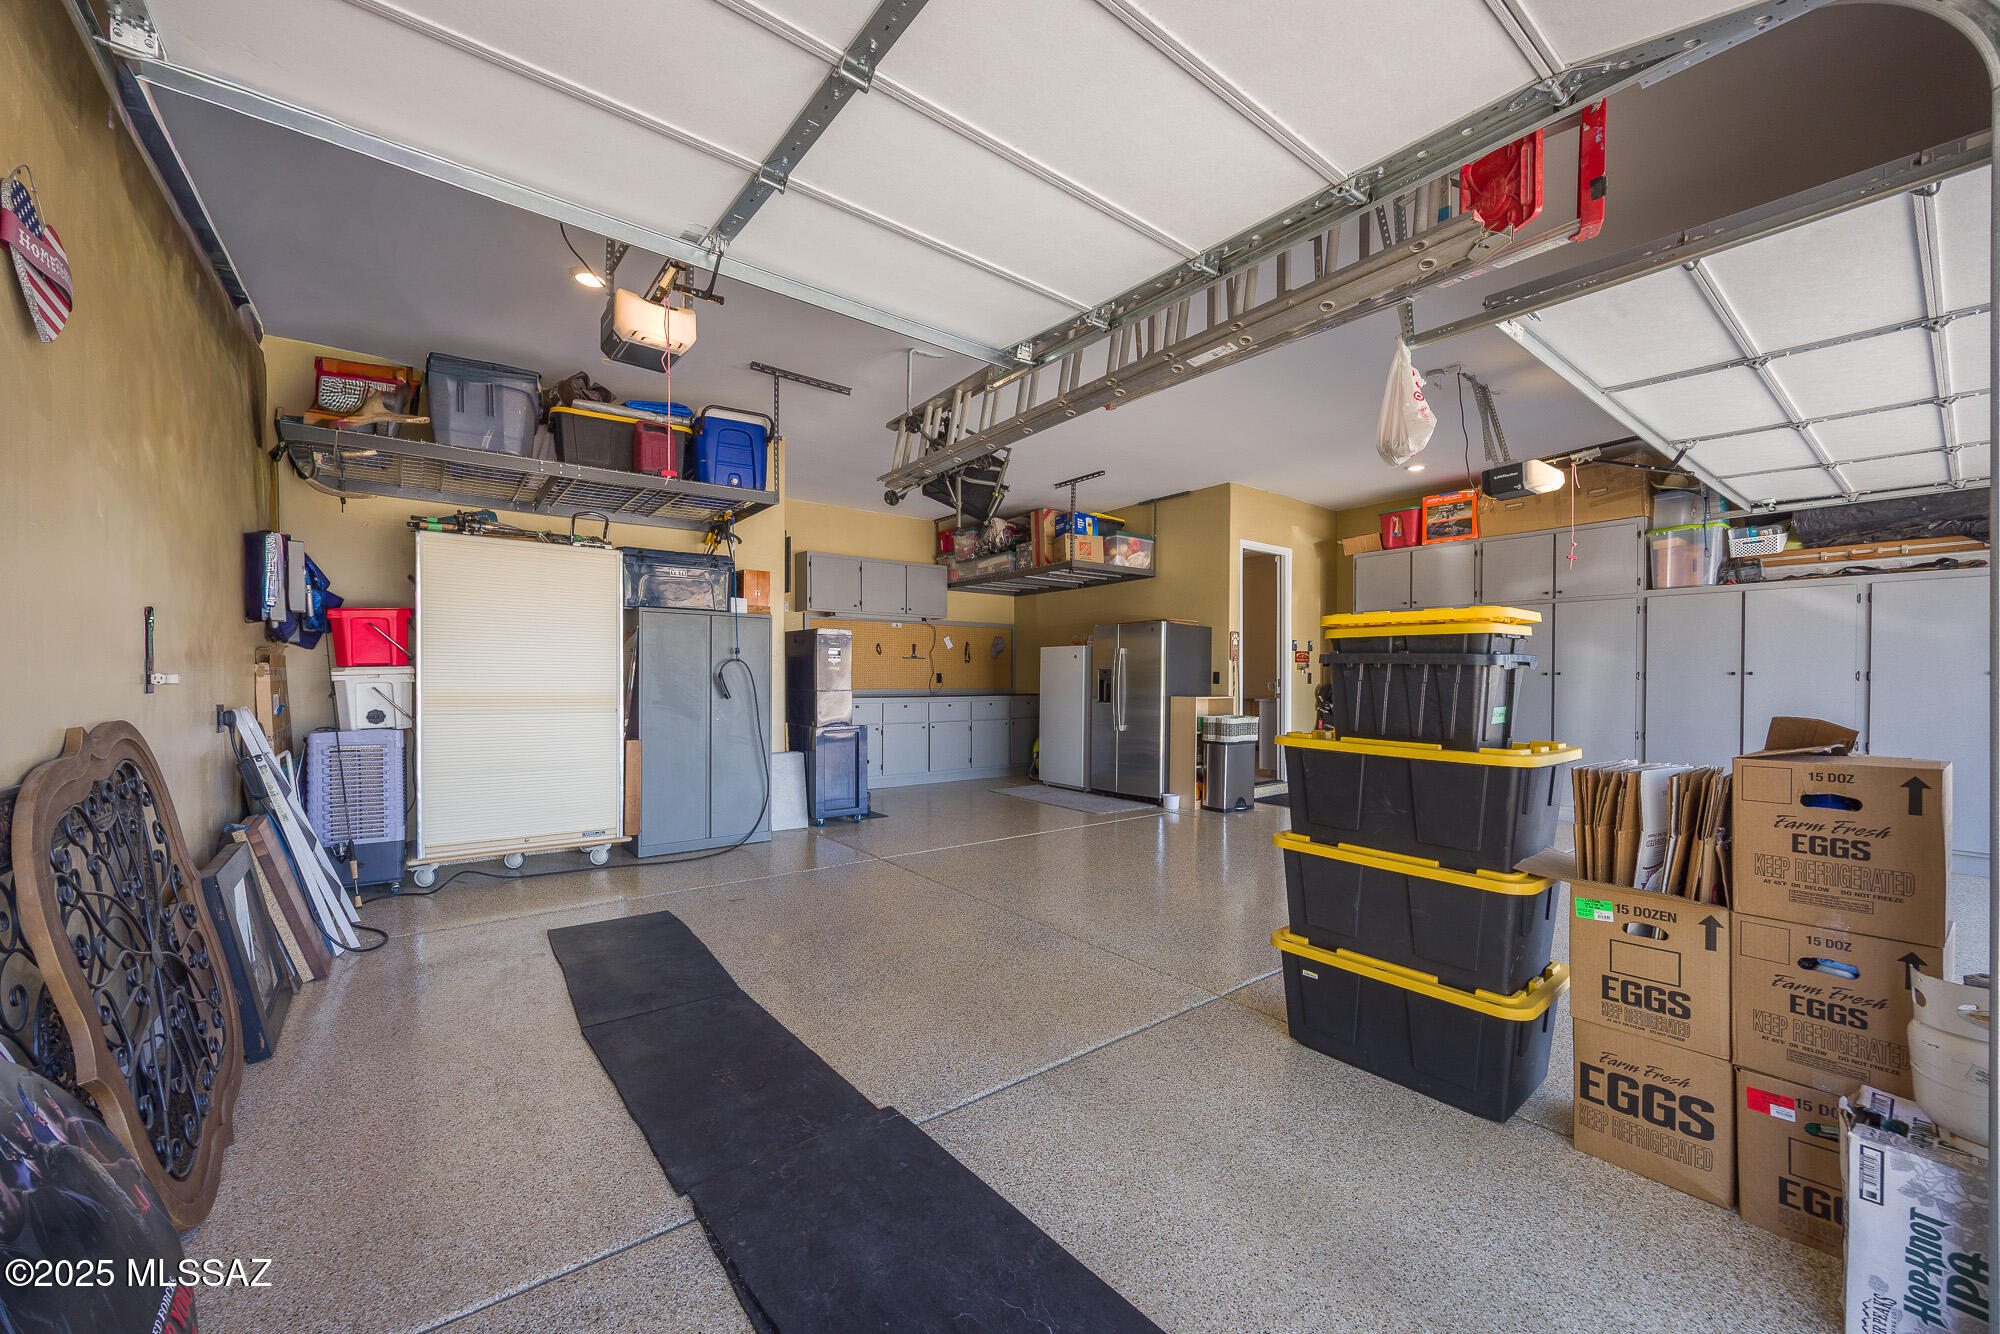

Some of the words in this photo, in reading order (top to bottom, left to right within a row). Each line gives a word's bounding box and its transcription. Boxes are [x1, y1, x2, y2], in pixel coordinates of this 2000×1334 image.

[1808, 772, 1824, 782] 15
[1827, 773, 1855, 784] DOZ
[1774, 814, 1827, 831] Farm
[1830, 820, 1894, 840] Fresh
[1791, 832, 1872, 862] EGGS
[1754, 852, 1791, 879] KEEP
[1794, 857, 1916, 898] REFRIGERATED
[1804, 884, 1830, 893] BELOW
[1854, 891, 1870, 899] NOT
[1872, 894, 1905, 904] FREEZE
[1614, 903, 1629, 915] 15
[1633, 906, 1677, 923] DOZEN
[1805, 935, 1821, 947] 15
[1825, 938, 1853, 953] DOZ
[1602, 974, 1691, 1020] EGGS
[1771, 973, 1824, 996] Farm
[1828, 986, 1889, 1010] Fresh
[1601, 1001, 1623, 1019] KEEP
[1624, 1007, 1691, 1039] REFRIGERATED
[1789, 993, 1869, 1030] EGGS
[1752, 1008, 1789, 1038] KEEP
[1792, 1018, 1911, 1071] REFRIGERATED
[1599, 1051, 1641, 1074] Farm
[1643, 1065, 1693, 1089] Fresh
[1579, 1061, 1715, 1142] EGGS
[1795, 1097, 1813, 1112] 15
[1579, 1103, 1609, 1134] KEEP
[1611, 1116, 1714, 1172] REFRIGERATED
[1946, 1251, 1989, 1323] IPA
[1873, 1293, 1897, 1327] PEAKS
